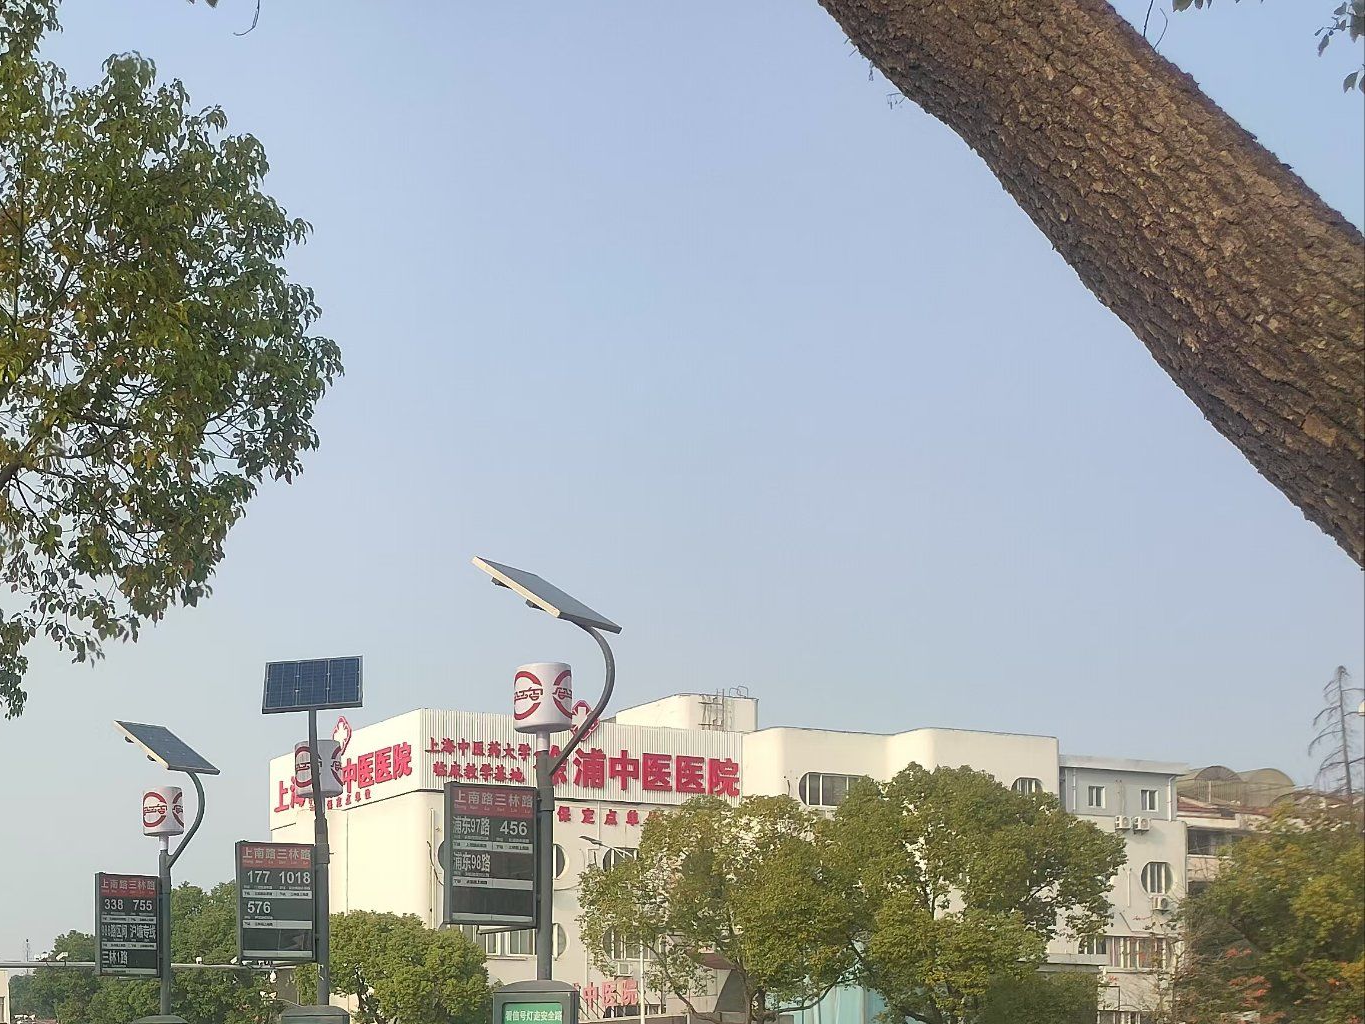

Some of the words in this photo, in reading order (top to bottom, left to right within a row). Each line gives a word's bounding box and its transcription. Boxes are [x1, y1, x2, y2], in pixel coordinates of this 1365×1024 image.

[453, 816, 490, 836] 浦东97路
[499, 820, 528, 836] 456
[453, 852, 491, 873] 浦东98路
[247, 870, 271, 883] 177
[279, 871, 311, 884] 1018
[104, 899, 124, 910] 338
[132, 899, 153, 911] 755
[247, 901, 271, 914] 576
